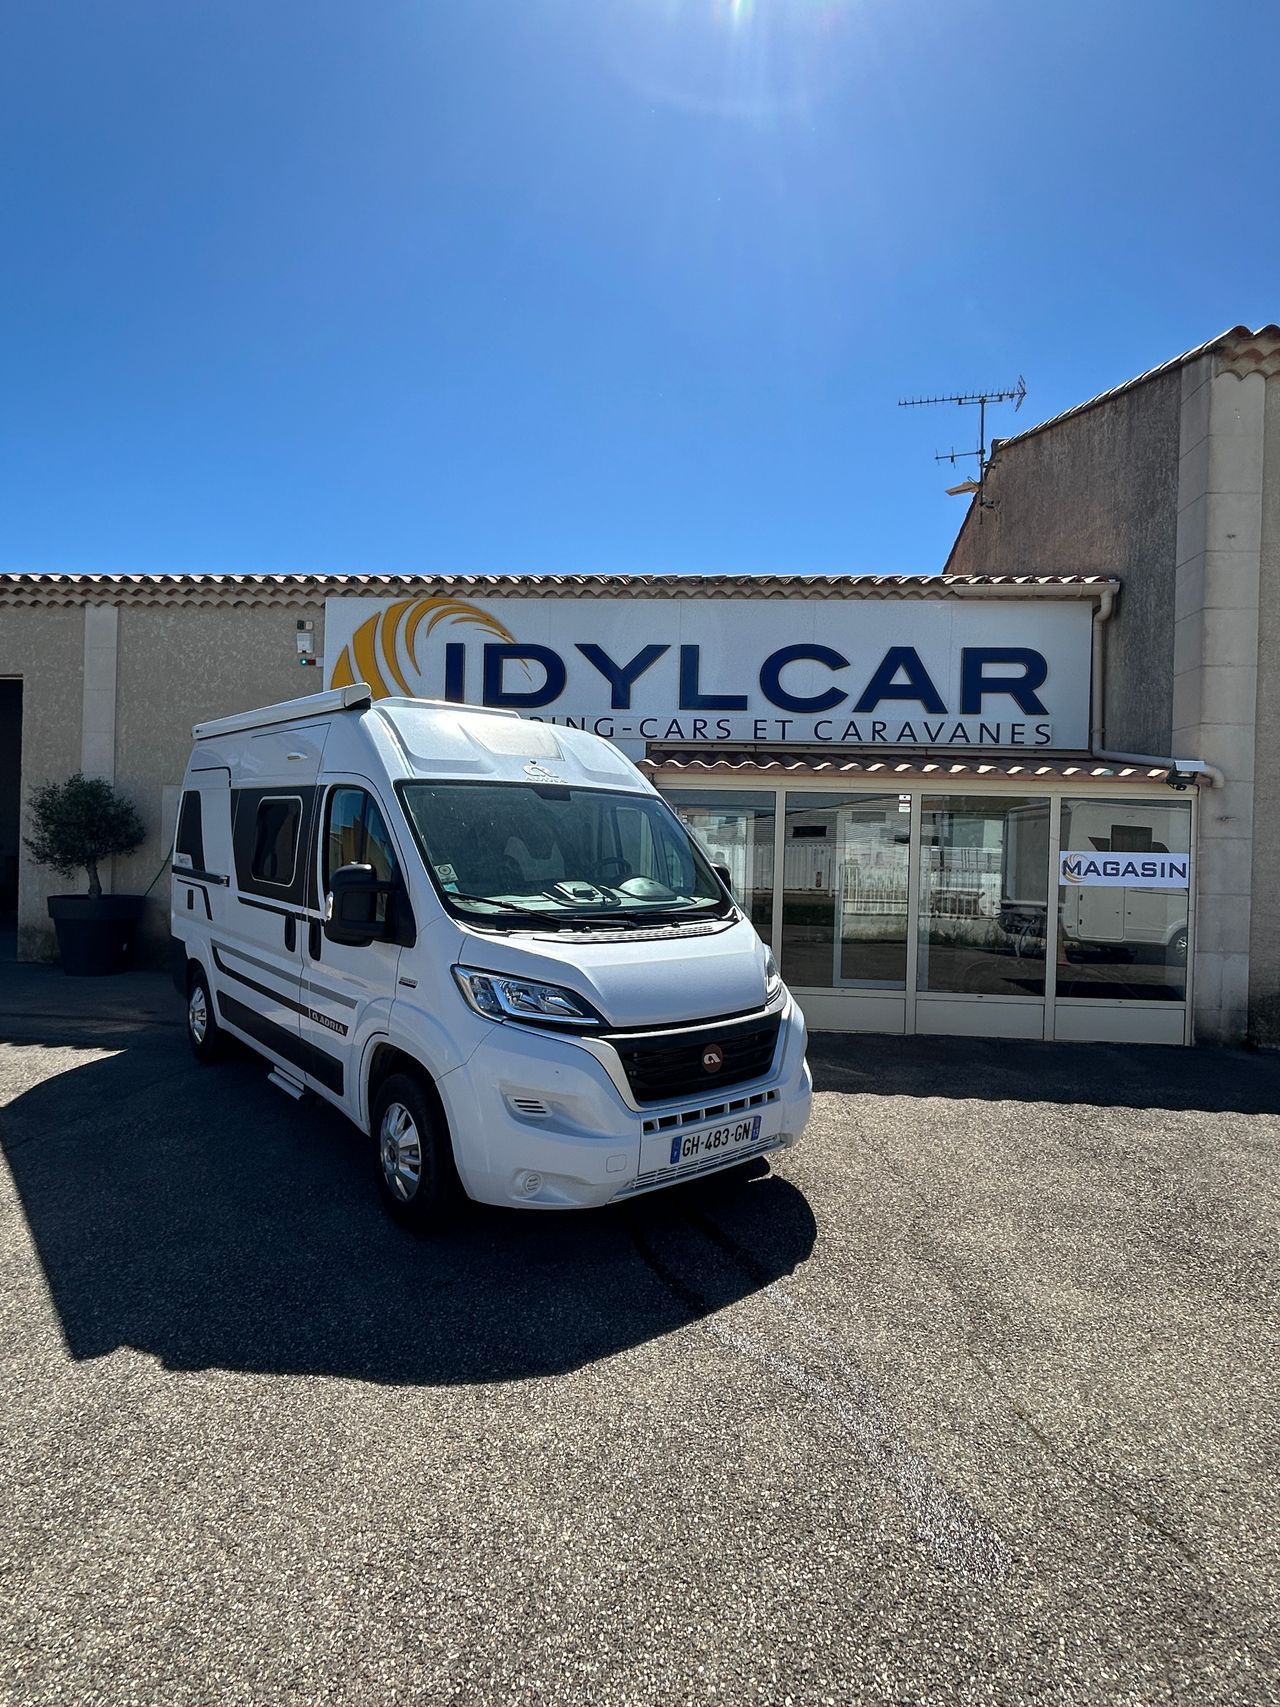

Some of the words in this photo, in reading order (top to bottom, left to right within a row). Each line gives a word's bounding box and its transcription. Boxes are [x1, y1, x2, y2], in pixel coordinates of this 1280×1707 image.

[445, 643, 1050, 715] IDYLCAR
[753, 719, 794, 740] ET
[813, 720, 1052, 745] CARAVANES
[1062, 860, 1187, 878] MAGASIN
[319, 1016, 345, 1034] ADRIA
[682, 1121, 751, 1157] GH-483-GN
